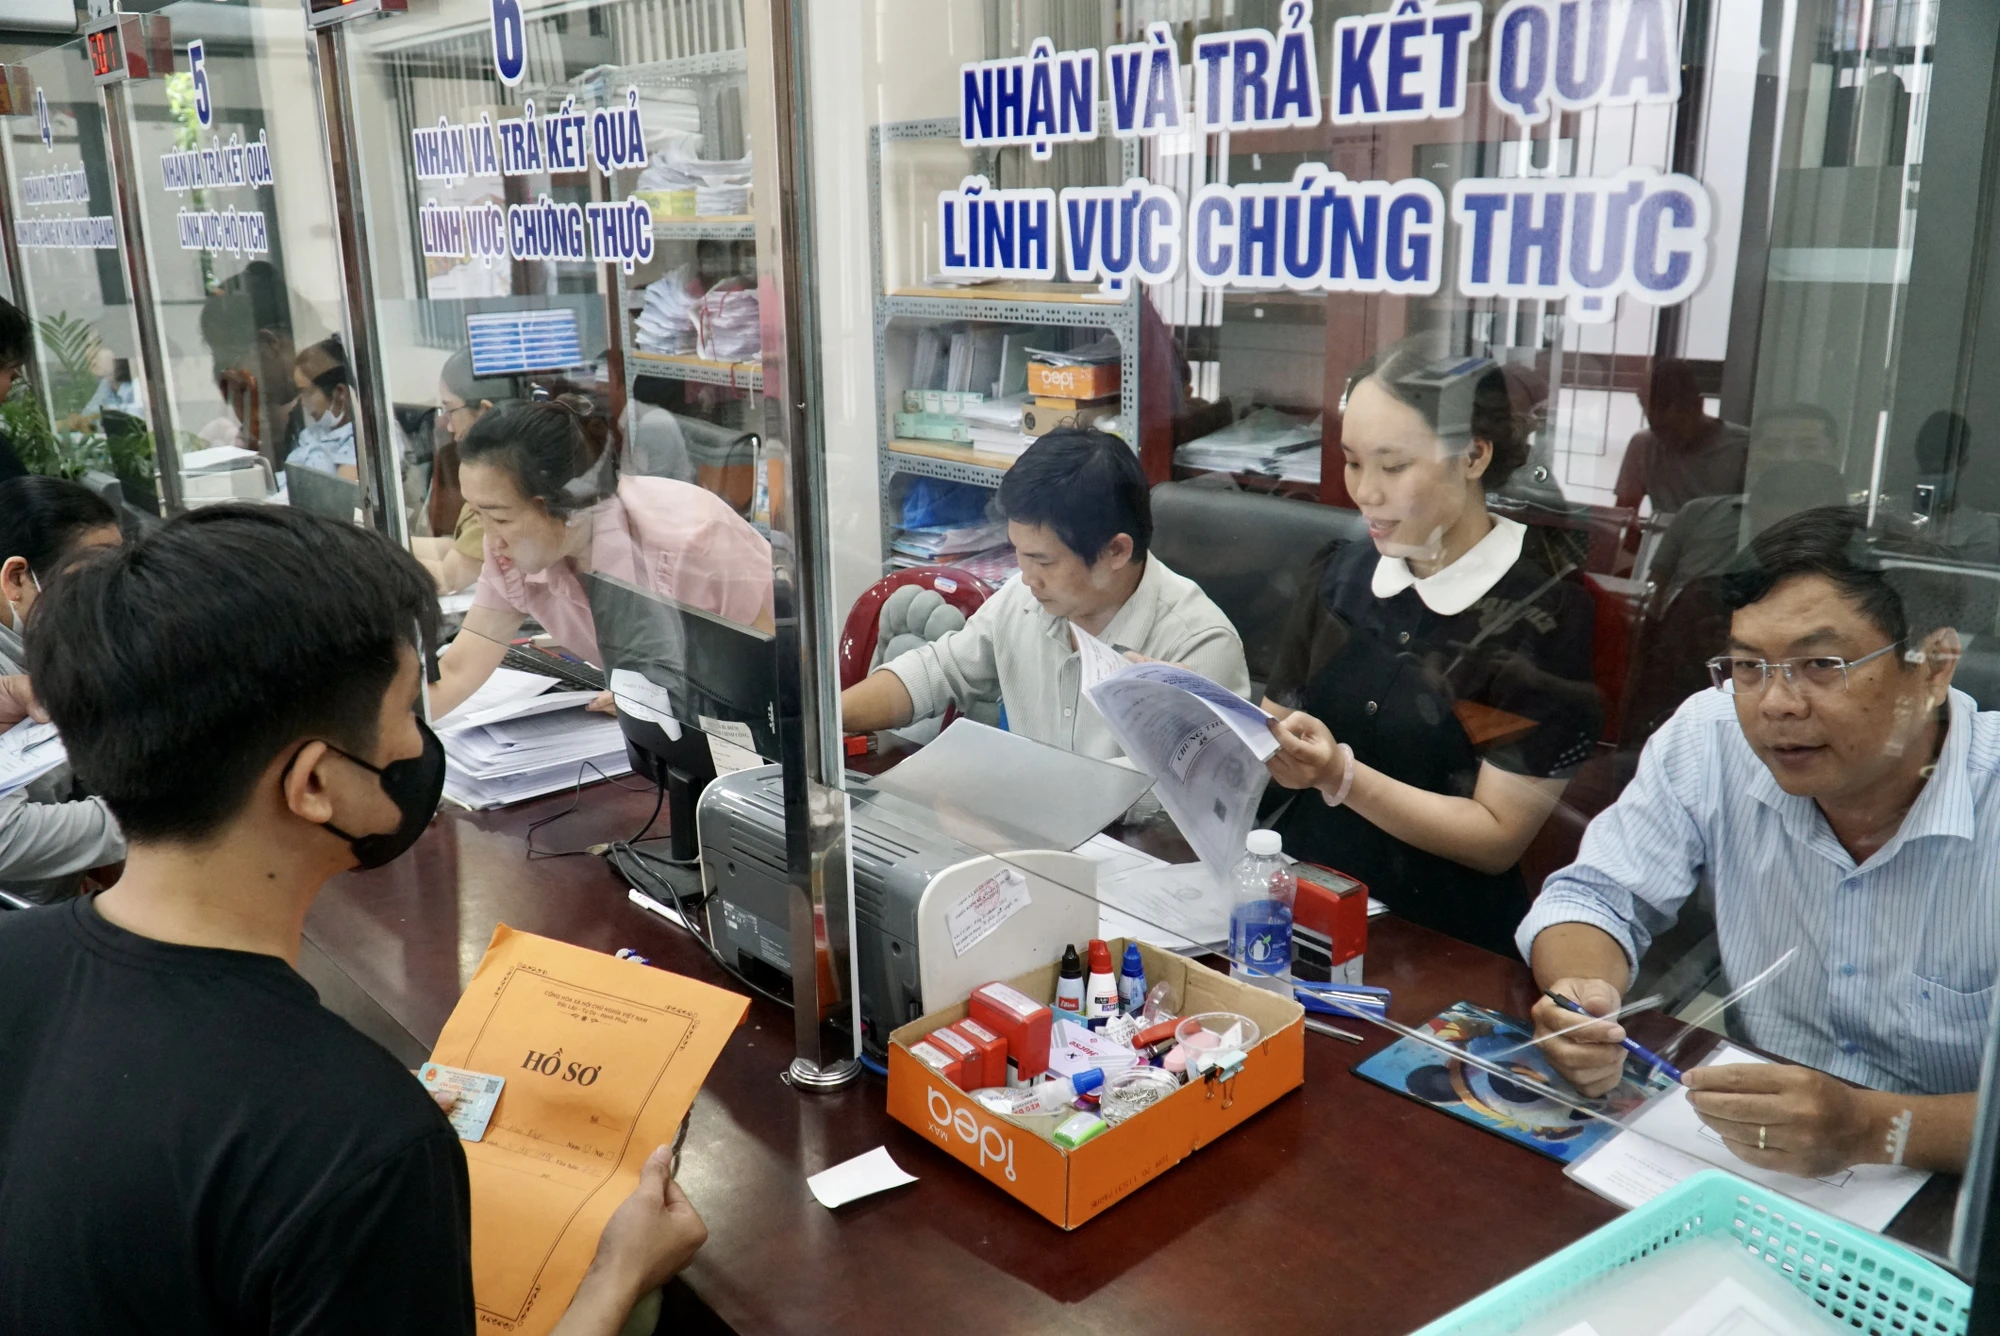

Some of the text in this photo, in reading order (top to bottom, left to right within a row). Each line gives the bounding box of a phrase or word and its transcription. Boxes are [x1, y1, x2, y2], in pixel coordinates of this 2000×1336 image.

[493, 0, 523, 78] 6
[189, 42, 210, 127] 5
[964, 45, 1094, 153] NHẬN
[1111, 31, 1180, 130] VÀ
[1199, 2, 1314, 124] TRẢ
[38, 91, 51, 149] 4
[414, 89, 645, 185] NHẬN VÀ TRẢ KẾT QUẢ
[161, 129, 273, 195] NHẬN VÀ TRẢ KẾT QUẢ
[178, 206, 267, 259] LĨNH VỰC HỘ TỊCH
[421, 198, 652, 270] LĨNH VỰC CHỨNG THỰC
[944, 176, 1696, 311] LĨNH VỰC CHỨNG THỰC
[520, 1047, 602, 1087] HỒ SƠ
[1068, 1040, 1099, 1056] Horse
[928, 1121, 948, 1142] MAX
